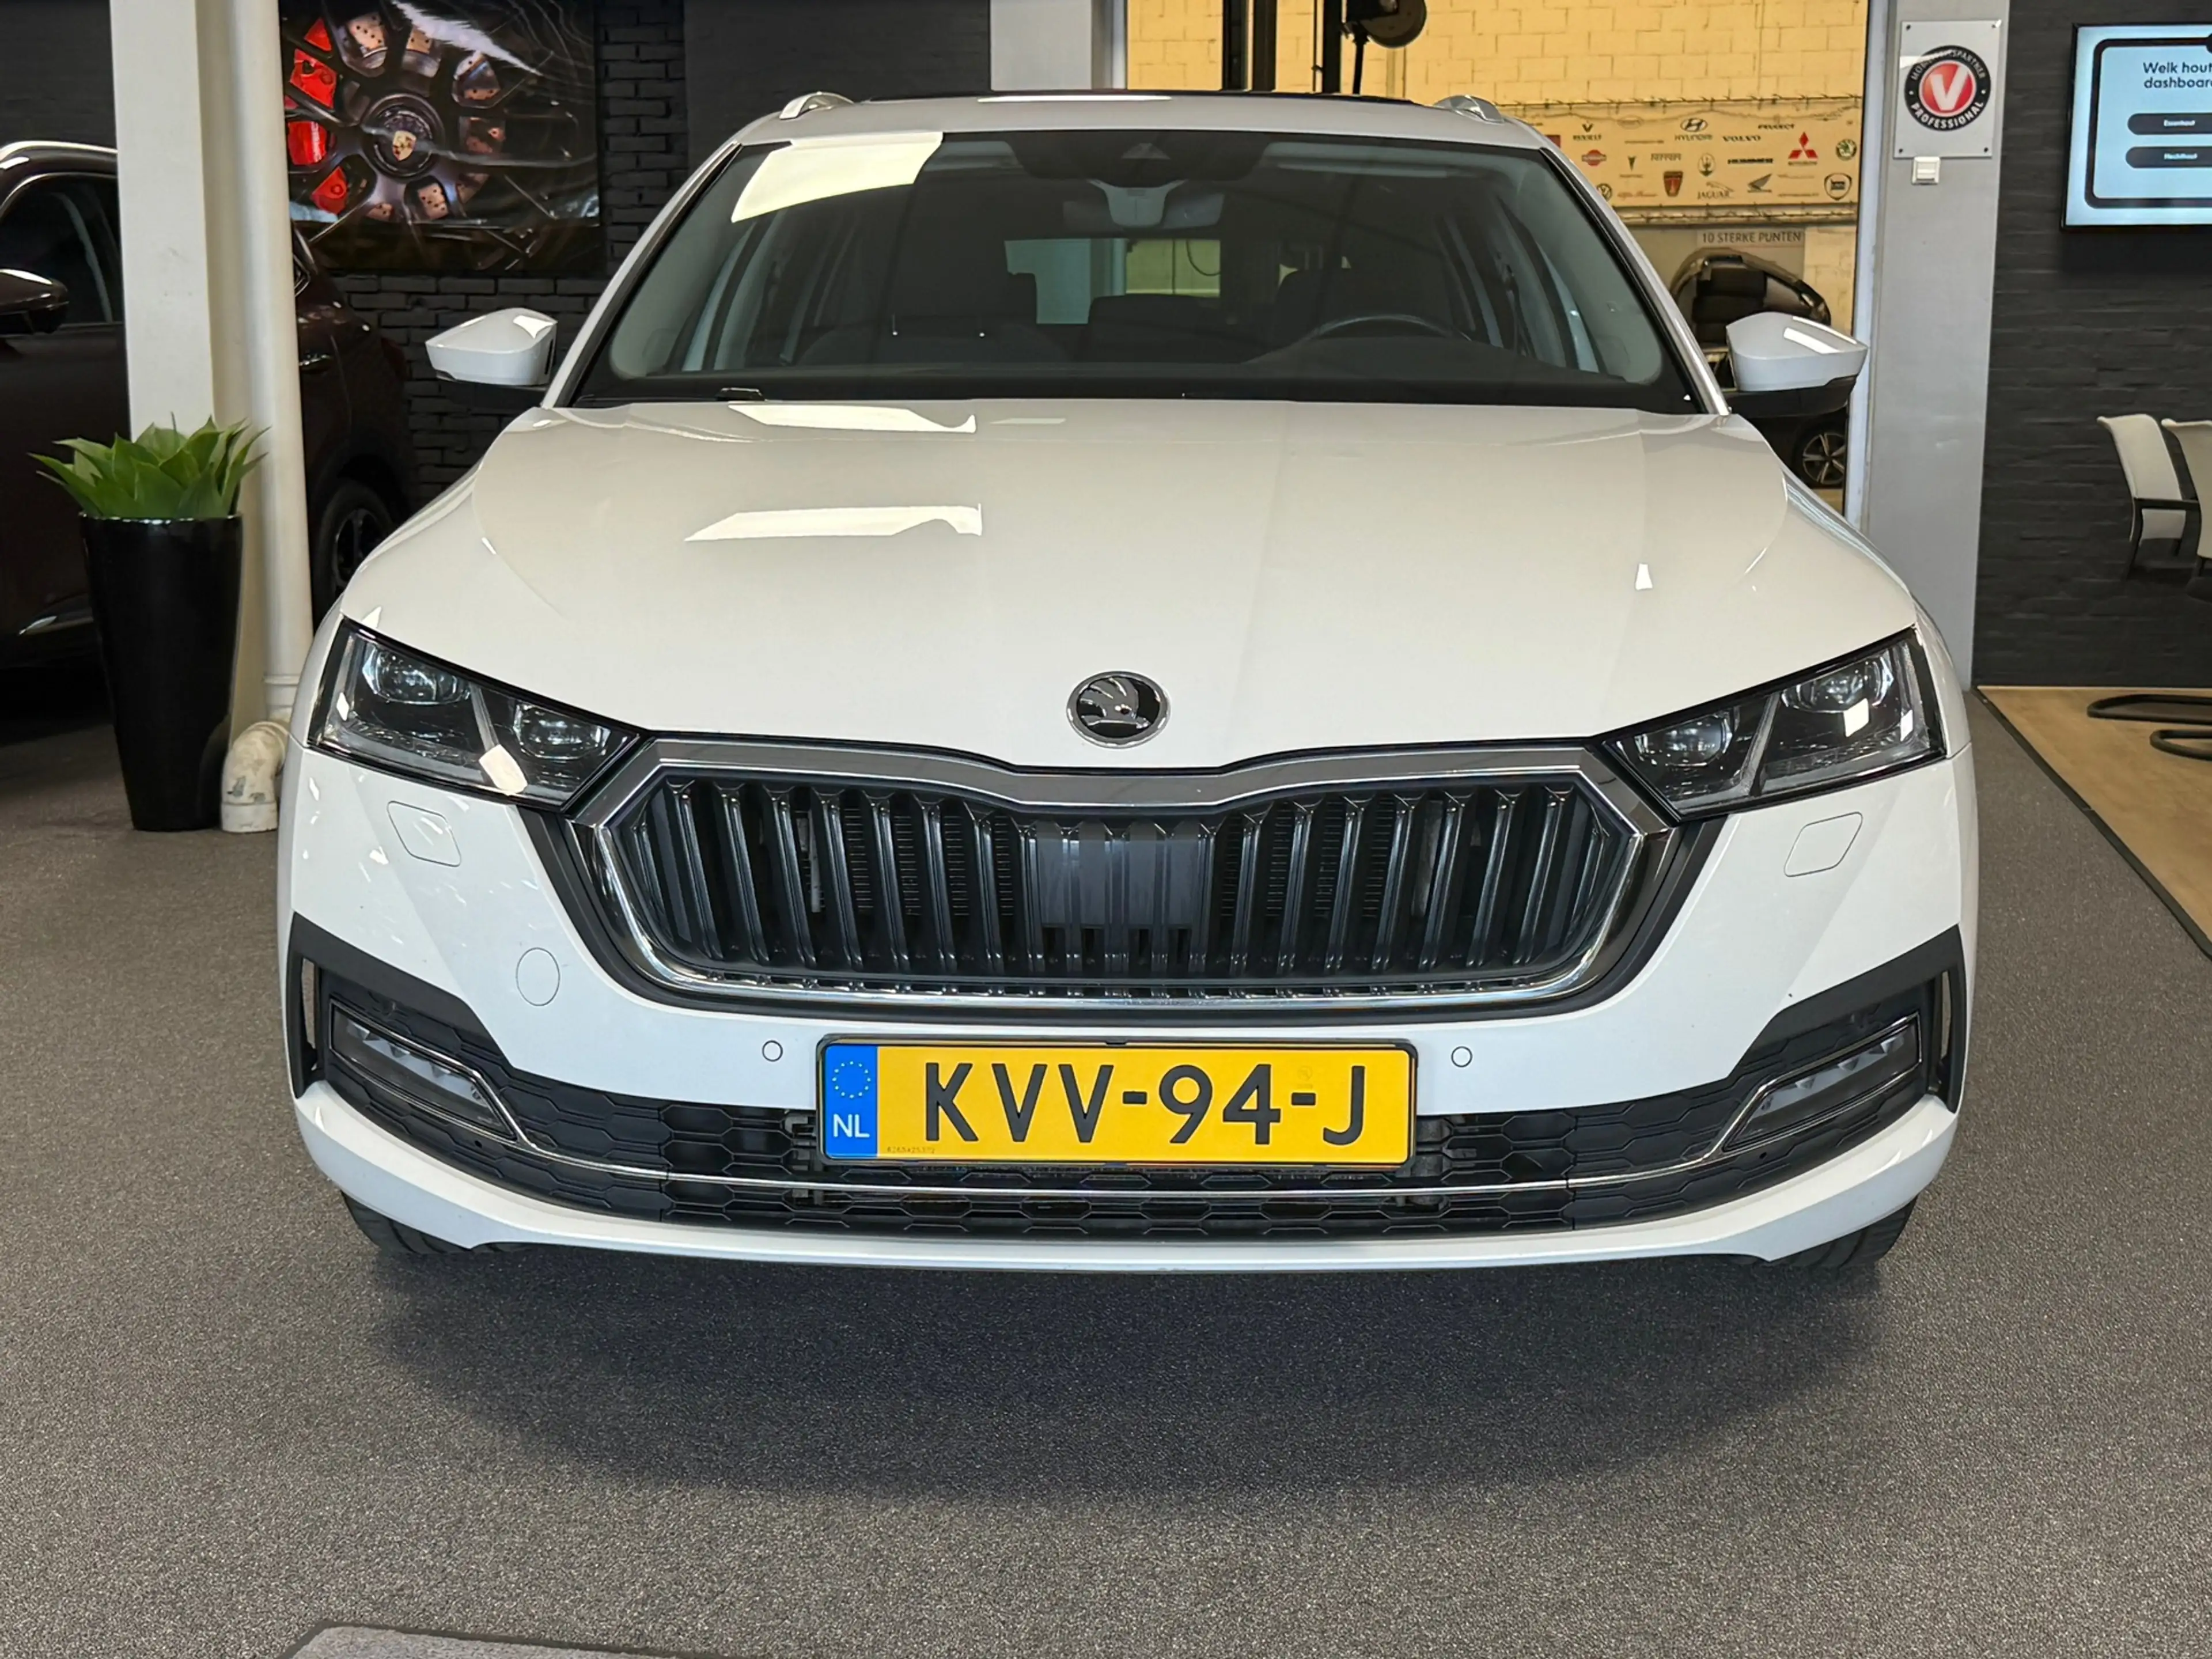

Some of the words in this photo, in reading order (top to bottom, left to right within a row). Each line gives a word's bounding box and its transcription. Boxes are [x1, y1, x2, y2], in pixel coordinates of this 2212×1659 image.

[2142, 62, 2177, 74] Welk
[2143, 77, 2212, 88] dashboar
[1910, 102, 1984, 129] PROFESSIONAL
[1702, 233, 1714, 243] 10
[1717, 232, 1754, 243] STERKE
[1758, 232, 1801, 243] PUNTEN
[925, 1062, 1365, 1146] KVV-94-J
[833, 1113, 870, 1138] NL
